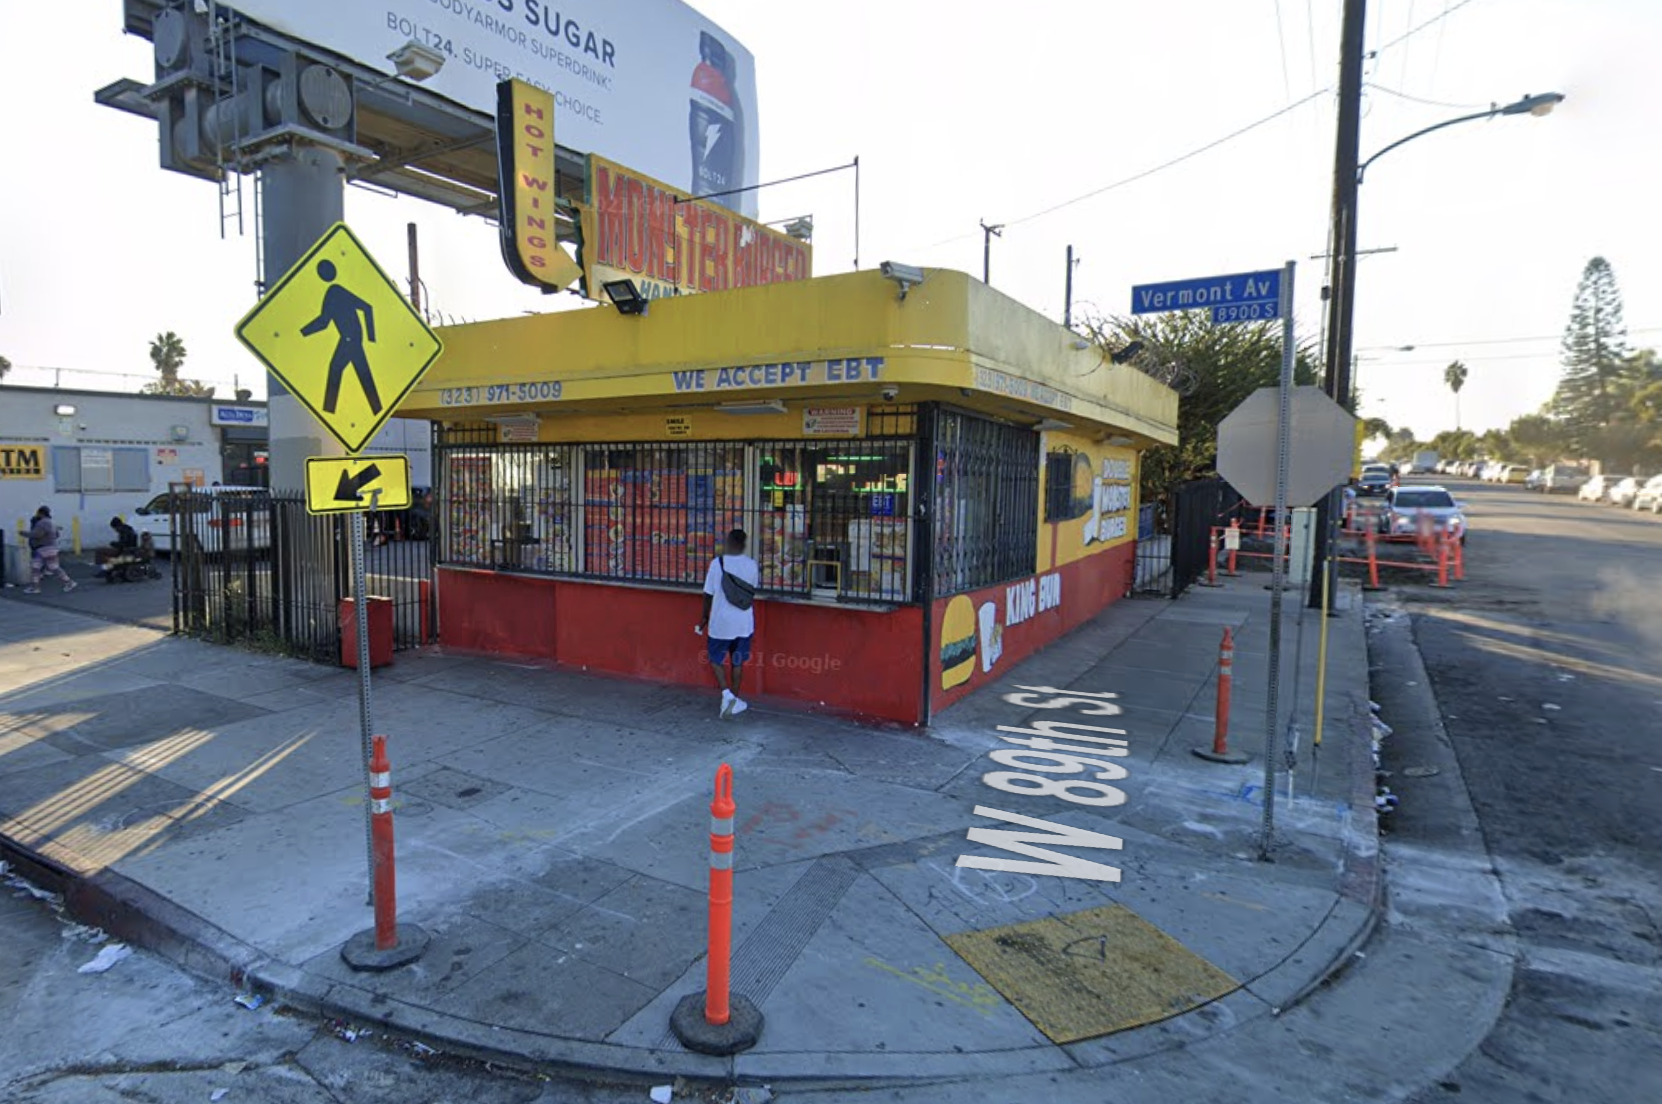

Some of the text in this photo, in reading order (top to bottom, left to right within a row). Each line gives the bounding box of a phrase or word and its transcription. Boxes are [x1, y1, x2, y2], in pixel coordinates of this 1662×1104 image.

[429, 0, 527, 49] ODYARMOR
[524, 0, 616, 68] SUGAR
[555, 90, 604, 125] CHOICE.
[524, 103, 545, 158] HOT
[522, 174, 548, 268] WINGS
[1141, 277, 1270, 308] Vermont Av
[1217, 303, 1274, 321] 8900 S
[672, 356, 885, 391] WE ACCEPT EBT
[441, 380, 562, 405] (323) 971-5009
[0, 448, 40, 467] TM
[1006, 577, 1036, 627] KING
